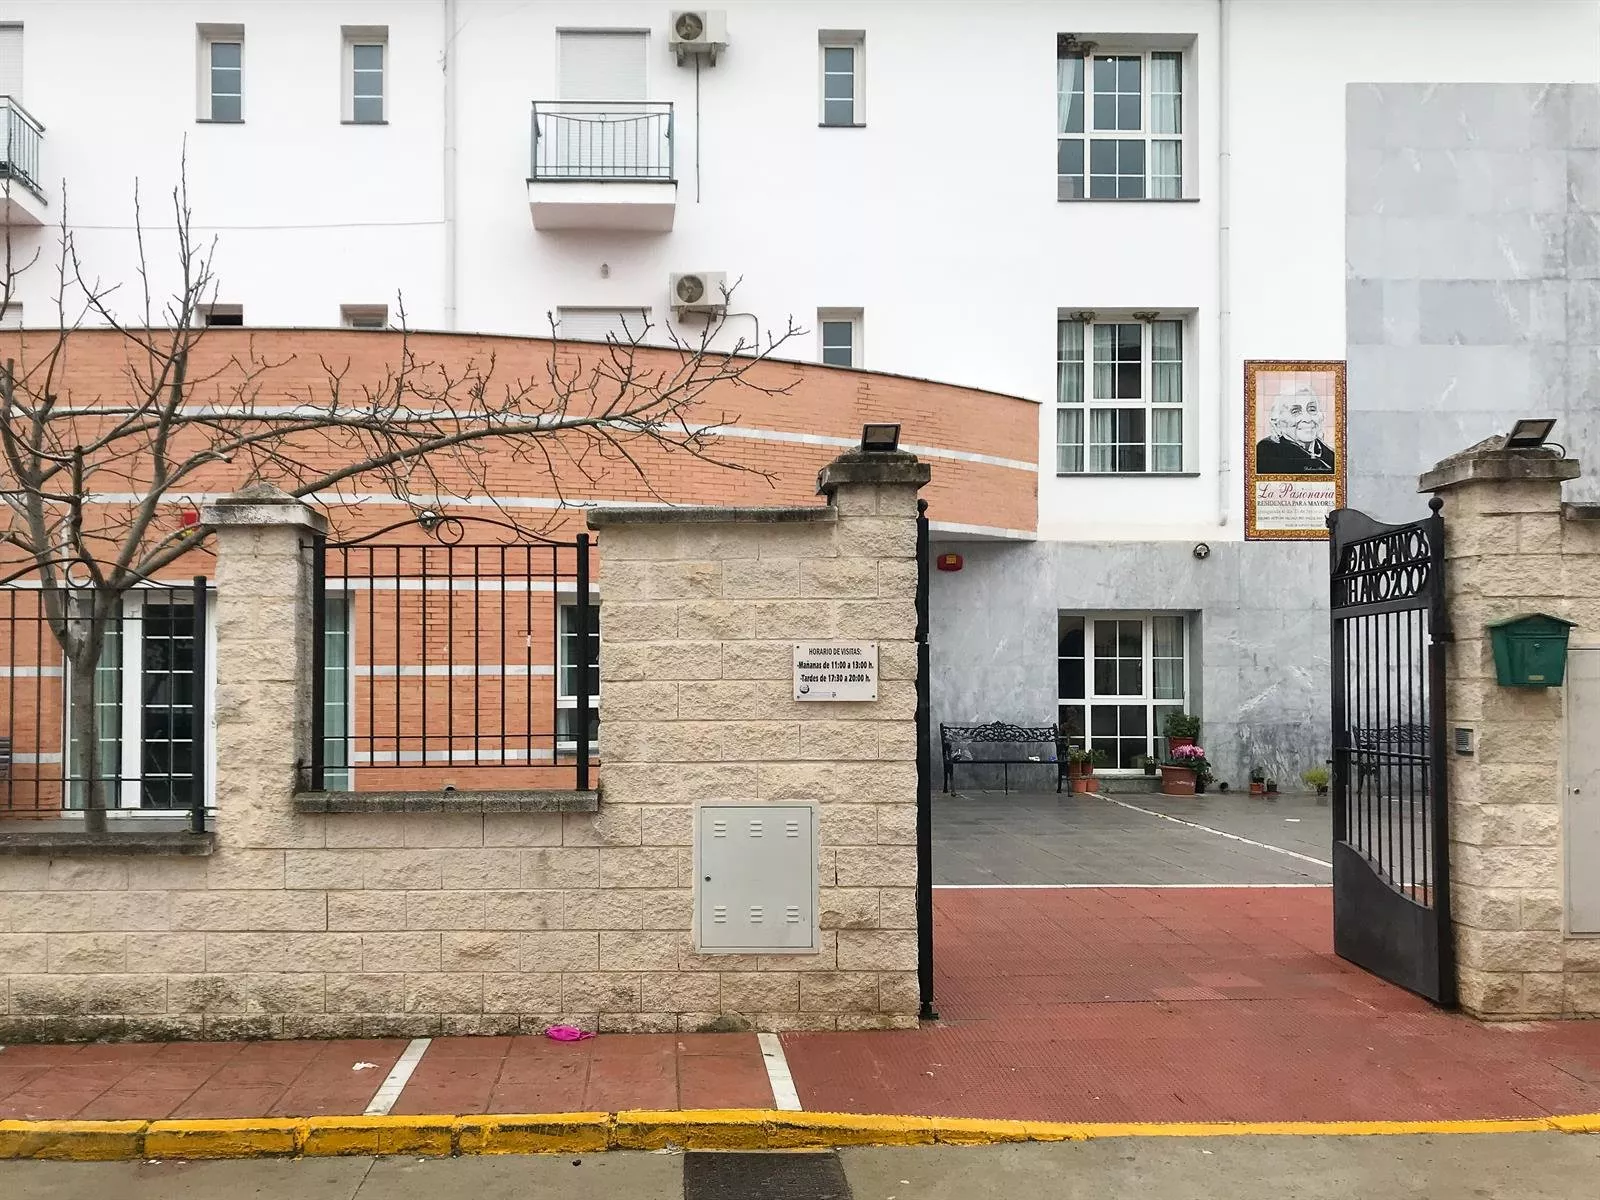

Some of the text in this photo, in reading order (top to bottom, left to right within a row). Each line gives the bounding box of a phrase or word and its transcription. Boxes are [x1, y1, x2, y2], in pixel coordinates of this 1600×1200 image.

[1257, 483, 1335, 499] La Pasionaria
[797, 660, 822, 668] -Mañanas
[852, 660, 867, 668] 13:00
[800, 674, 818, 682] -Tardes
[820, 674, 827, 682] de
[828, 674, 843, 682] 17:30
[849, 674, 865, 682] 20:00
[865, 674, 871, 682] h.
